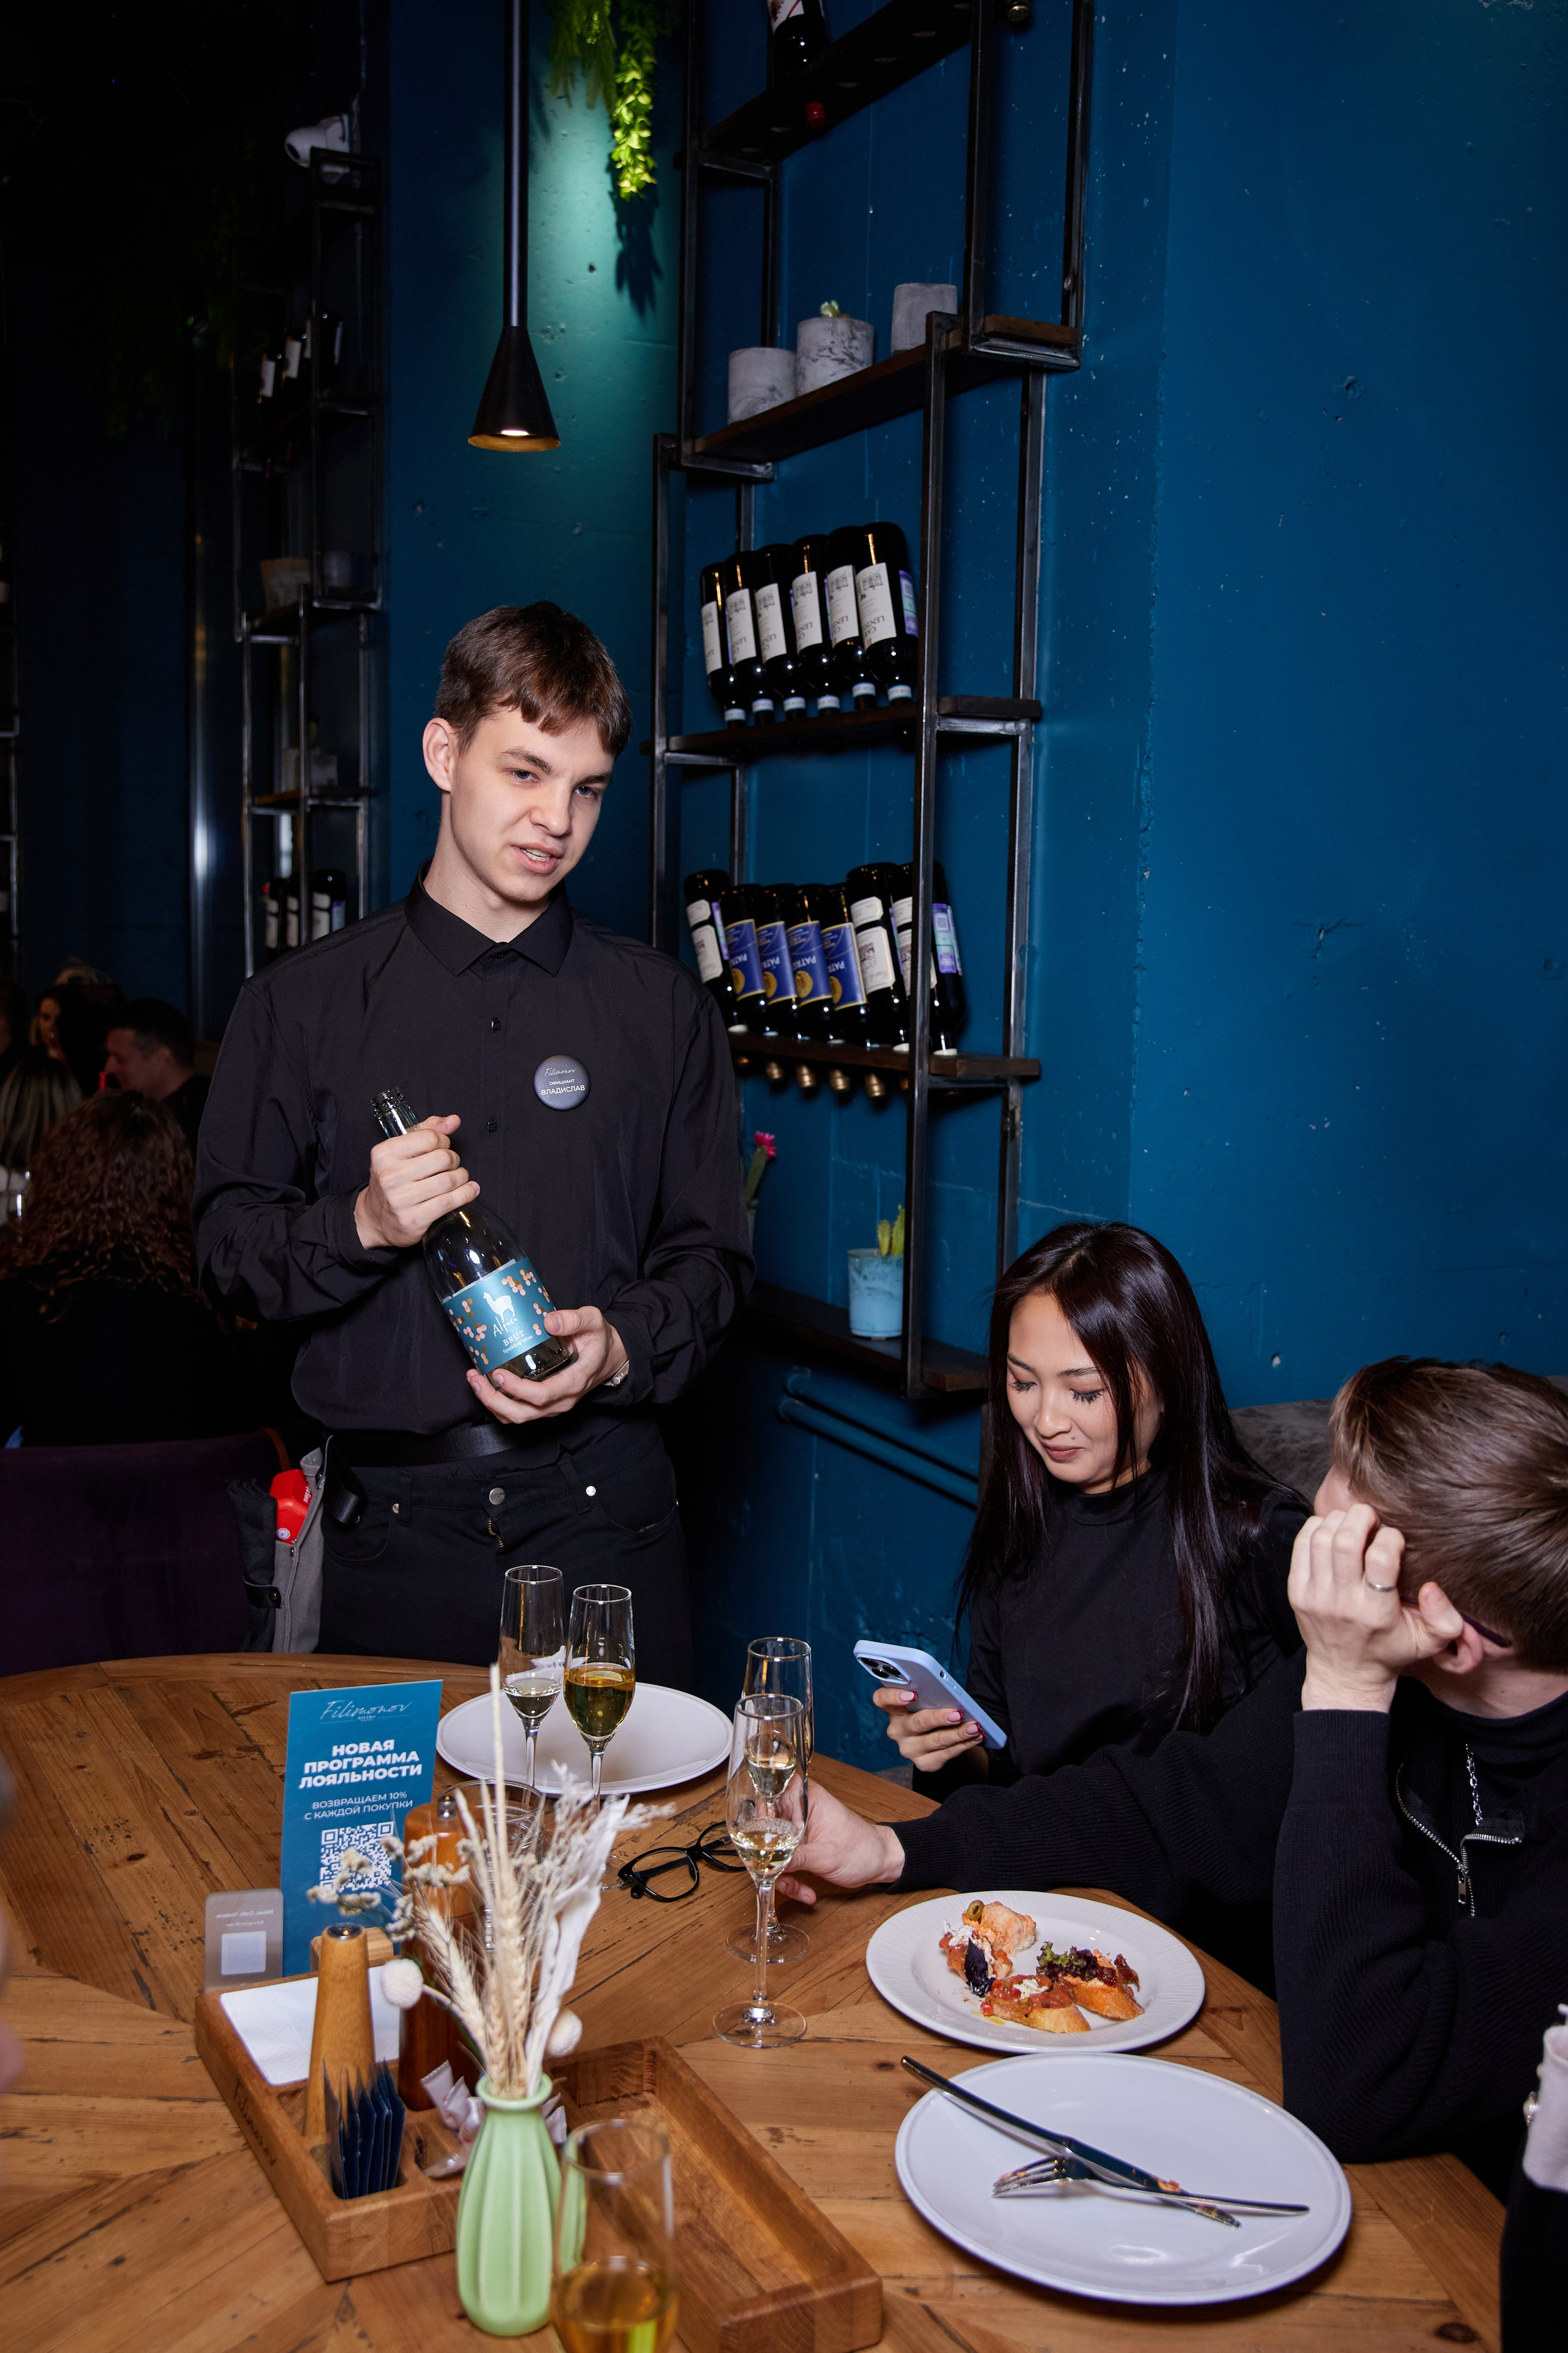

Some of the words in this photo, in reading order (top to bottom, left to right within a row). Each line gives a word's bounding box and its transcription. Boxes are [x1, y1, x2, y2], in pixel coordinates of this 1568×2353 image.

[541, 1085, 586, 1095] ВЛАДИСЛАВ
[493, 1316, 518, 1337] Alpaca
[503, 1330, 524, 1346] BRUT
[503, 1340, 522, 1354] Sparkling
[521, 1335, 533, 1343] Wine
[320, 1699, 412, 1720] Filimonov
[332, 1739, 394, 1756] НОВАЯ
[304, 1751, 420, 1773] ПРОГРАММА
[299, 1764, 422, 1789] ЛОЯЛЬНОСТИ
[313, 1794, 386, 1809] ВОЗВРАЩАЕМ
[390, 1791, 407, 1800] 10%
[314, 1805, 361, 1819] КАЖДОЙ
[363, 1800, 413, 1812] ПОКУПКИ
